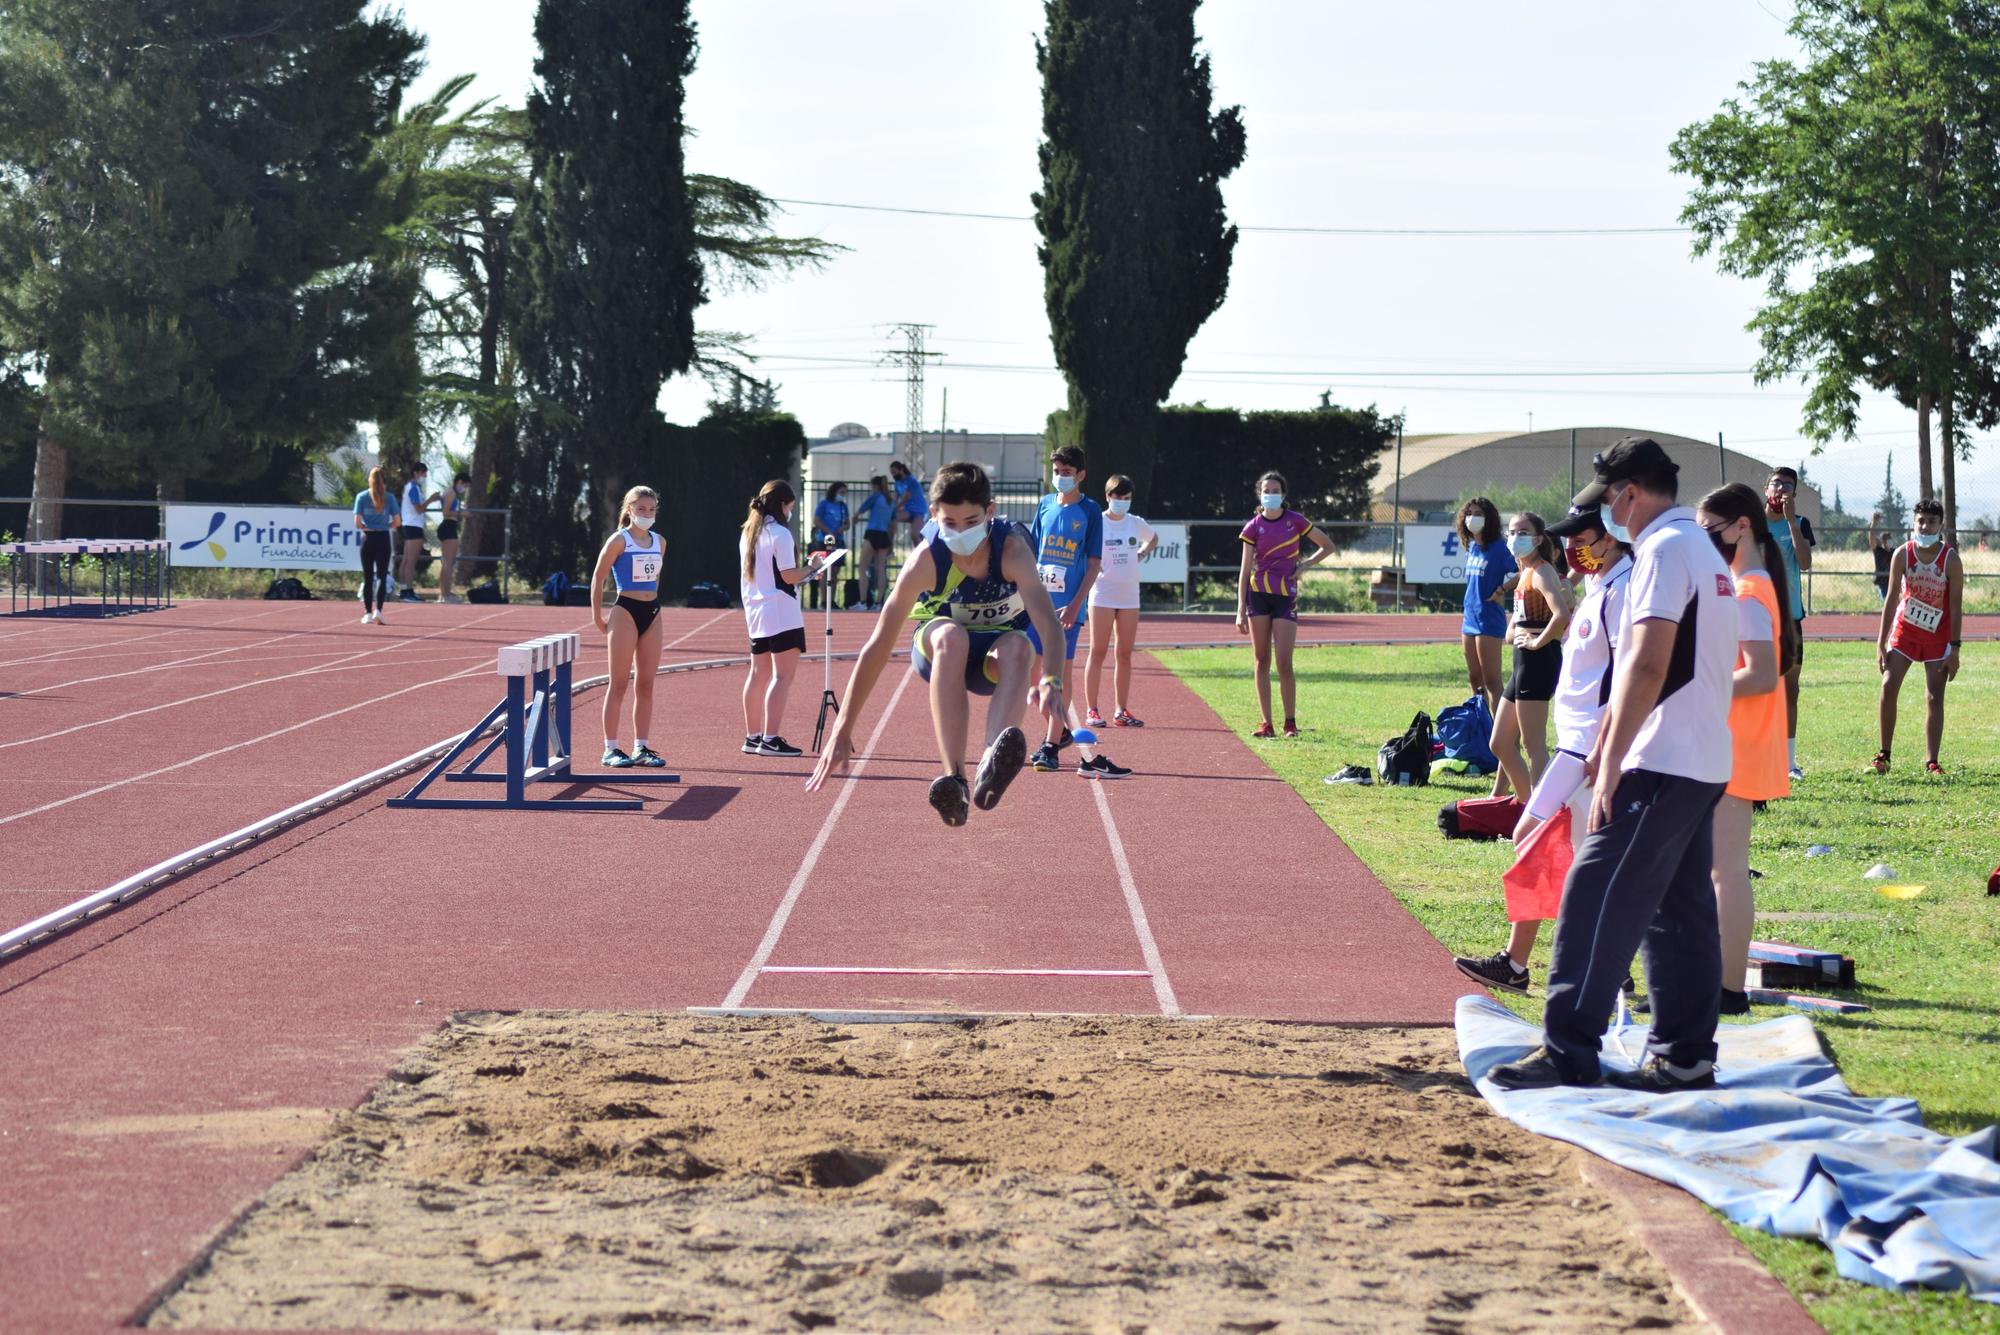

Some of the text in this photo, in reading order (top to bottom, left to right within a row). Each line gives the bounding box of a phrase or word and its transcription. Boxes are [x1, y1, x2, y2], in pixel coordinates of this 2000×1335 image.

[261, 545, 344, 560] Fundación
[644, 563, 655, 575] 69
[967, 602, 1010, 620] 708
[1910, 606, 1935, 625] 1111
